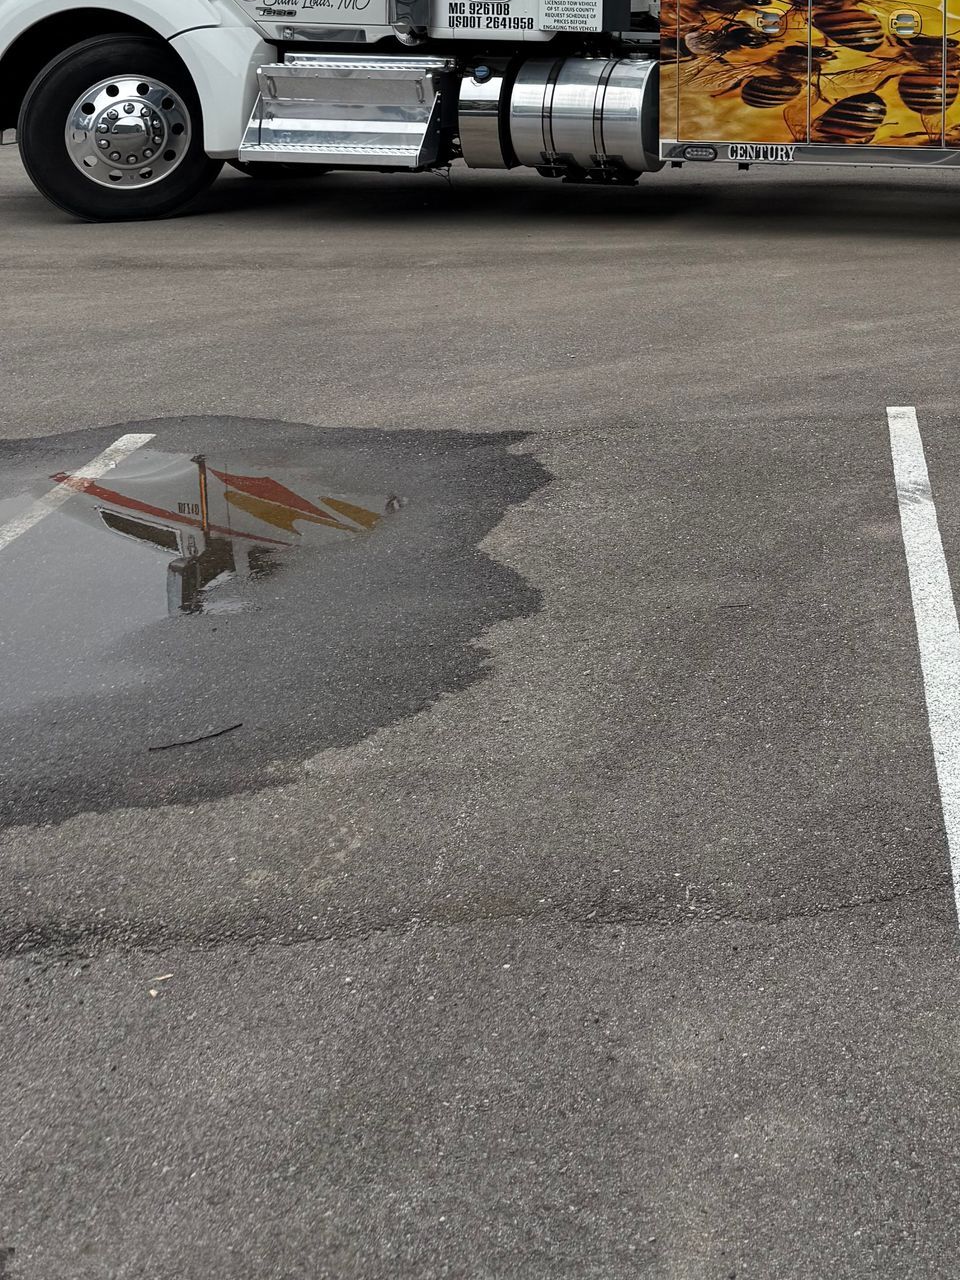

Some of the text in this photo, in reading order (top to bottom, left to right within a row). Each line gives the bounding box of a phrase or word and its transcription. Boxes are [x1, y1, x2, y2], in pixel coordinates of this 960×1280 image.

[448, 2, 510, 16] MC 926108
[448, 15, 534, 30] USDOT 2641958
[728, 144, 796, 161] CENTURY
